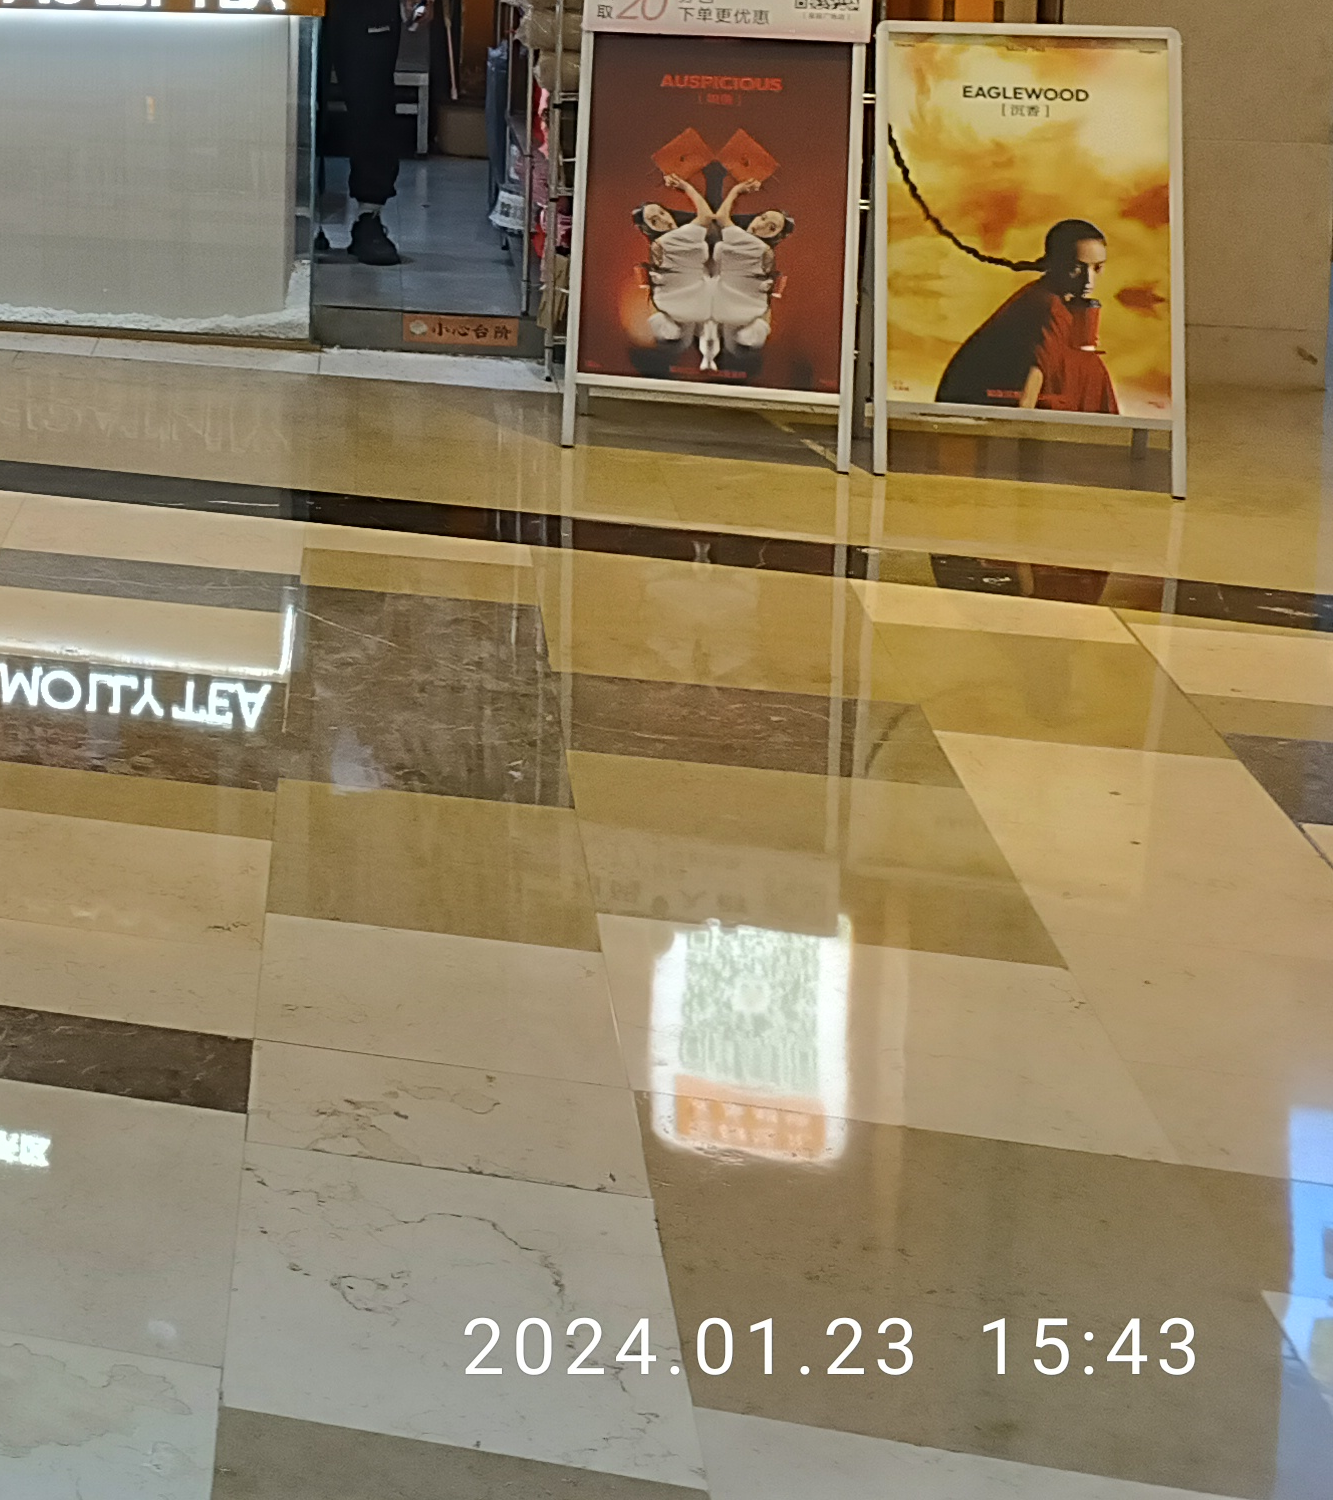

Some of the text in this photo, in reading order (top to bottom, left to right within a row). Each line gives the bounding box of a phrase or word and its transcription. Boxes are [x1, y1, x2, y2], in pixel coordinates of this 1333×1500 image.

[679, 8, 771, 26] 下单更优惠
[659, 73, 783, 92] AUSPICIOUS
[962, 85, 1090, 102] EAGLEWOOD
